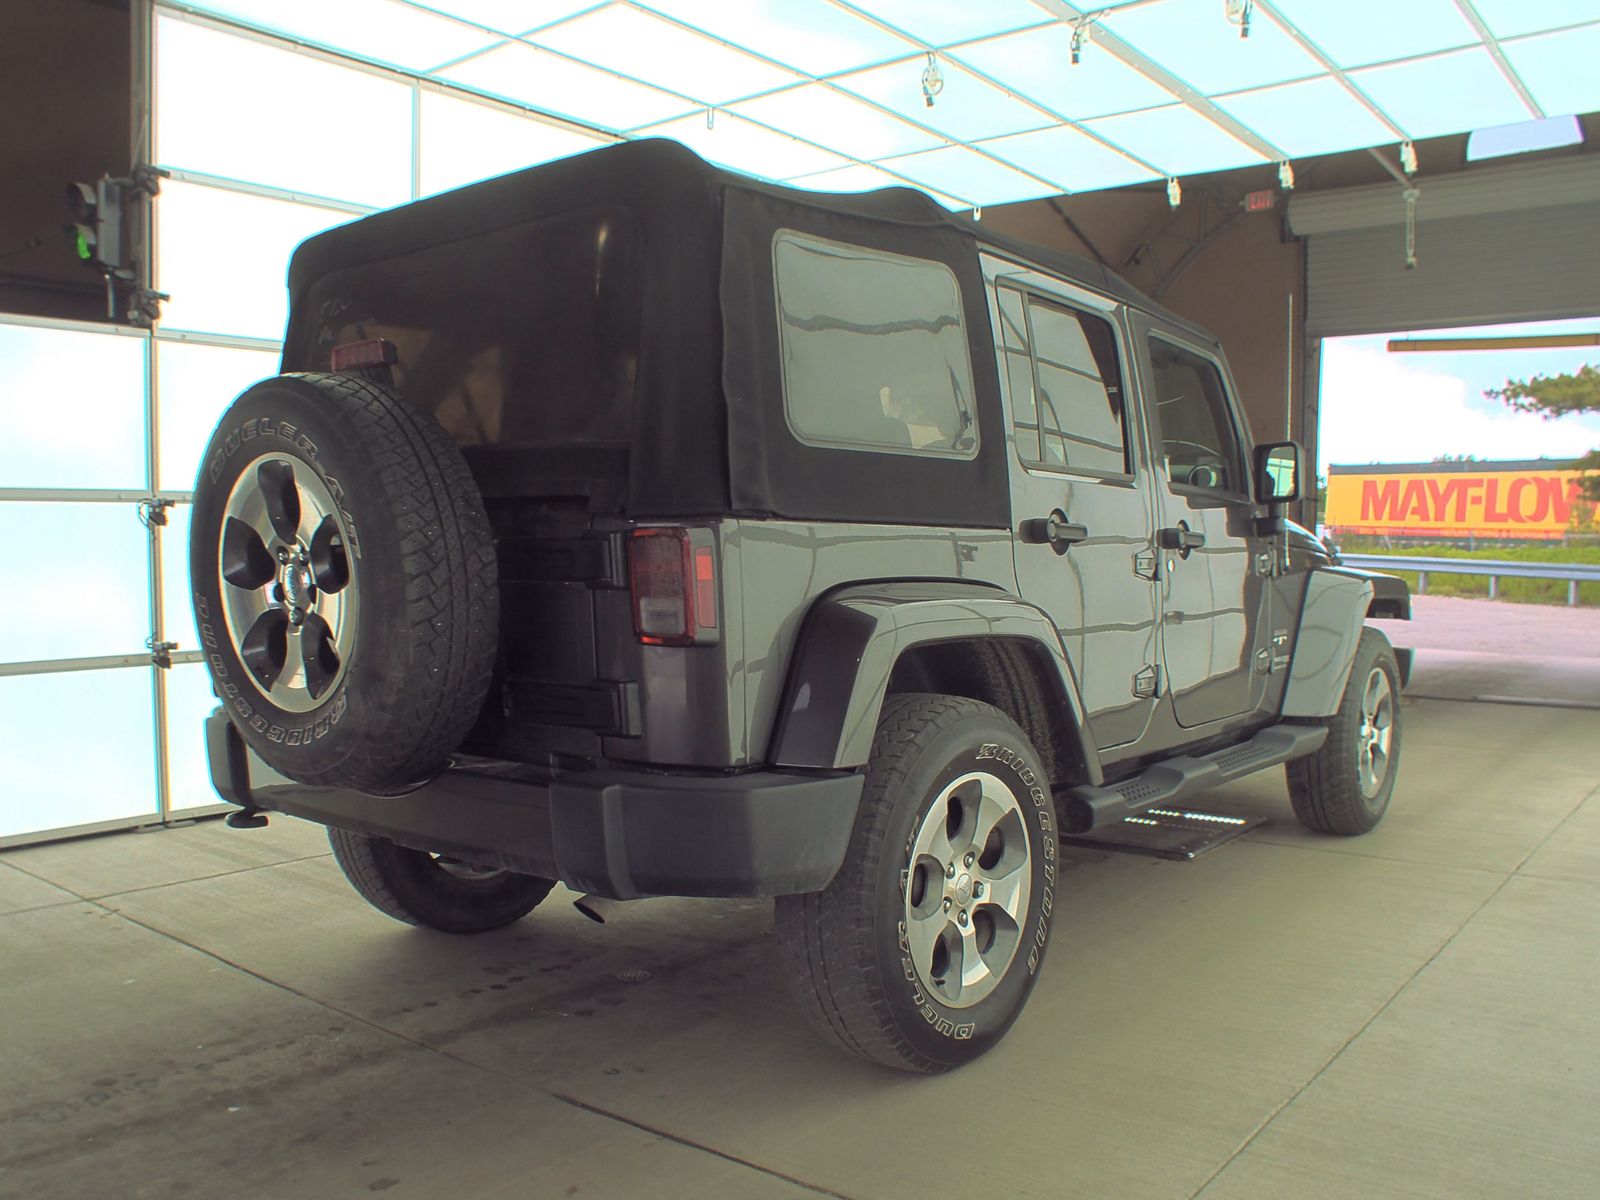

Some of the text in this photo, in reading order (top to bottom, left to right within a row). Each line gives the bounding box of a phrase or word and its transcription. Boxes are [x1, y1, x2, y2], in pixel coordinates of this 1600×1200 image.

[209, 417, 319, 484] DUELER
[195, 592, 347, 746] BRIDGESTONE
[975, 743, 1055, 975] BRIDGESTONE
[899, 921, 975, 1039] DUELER
